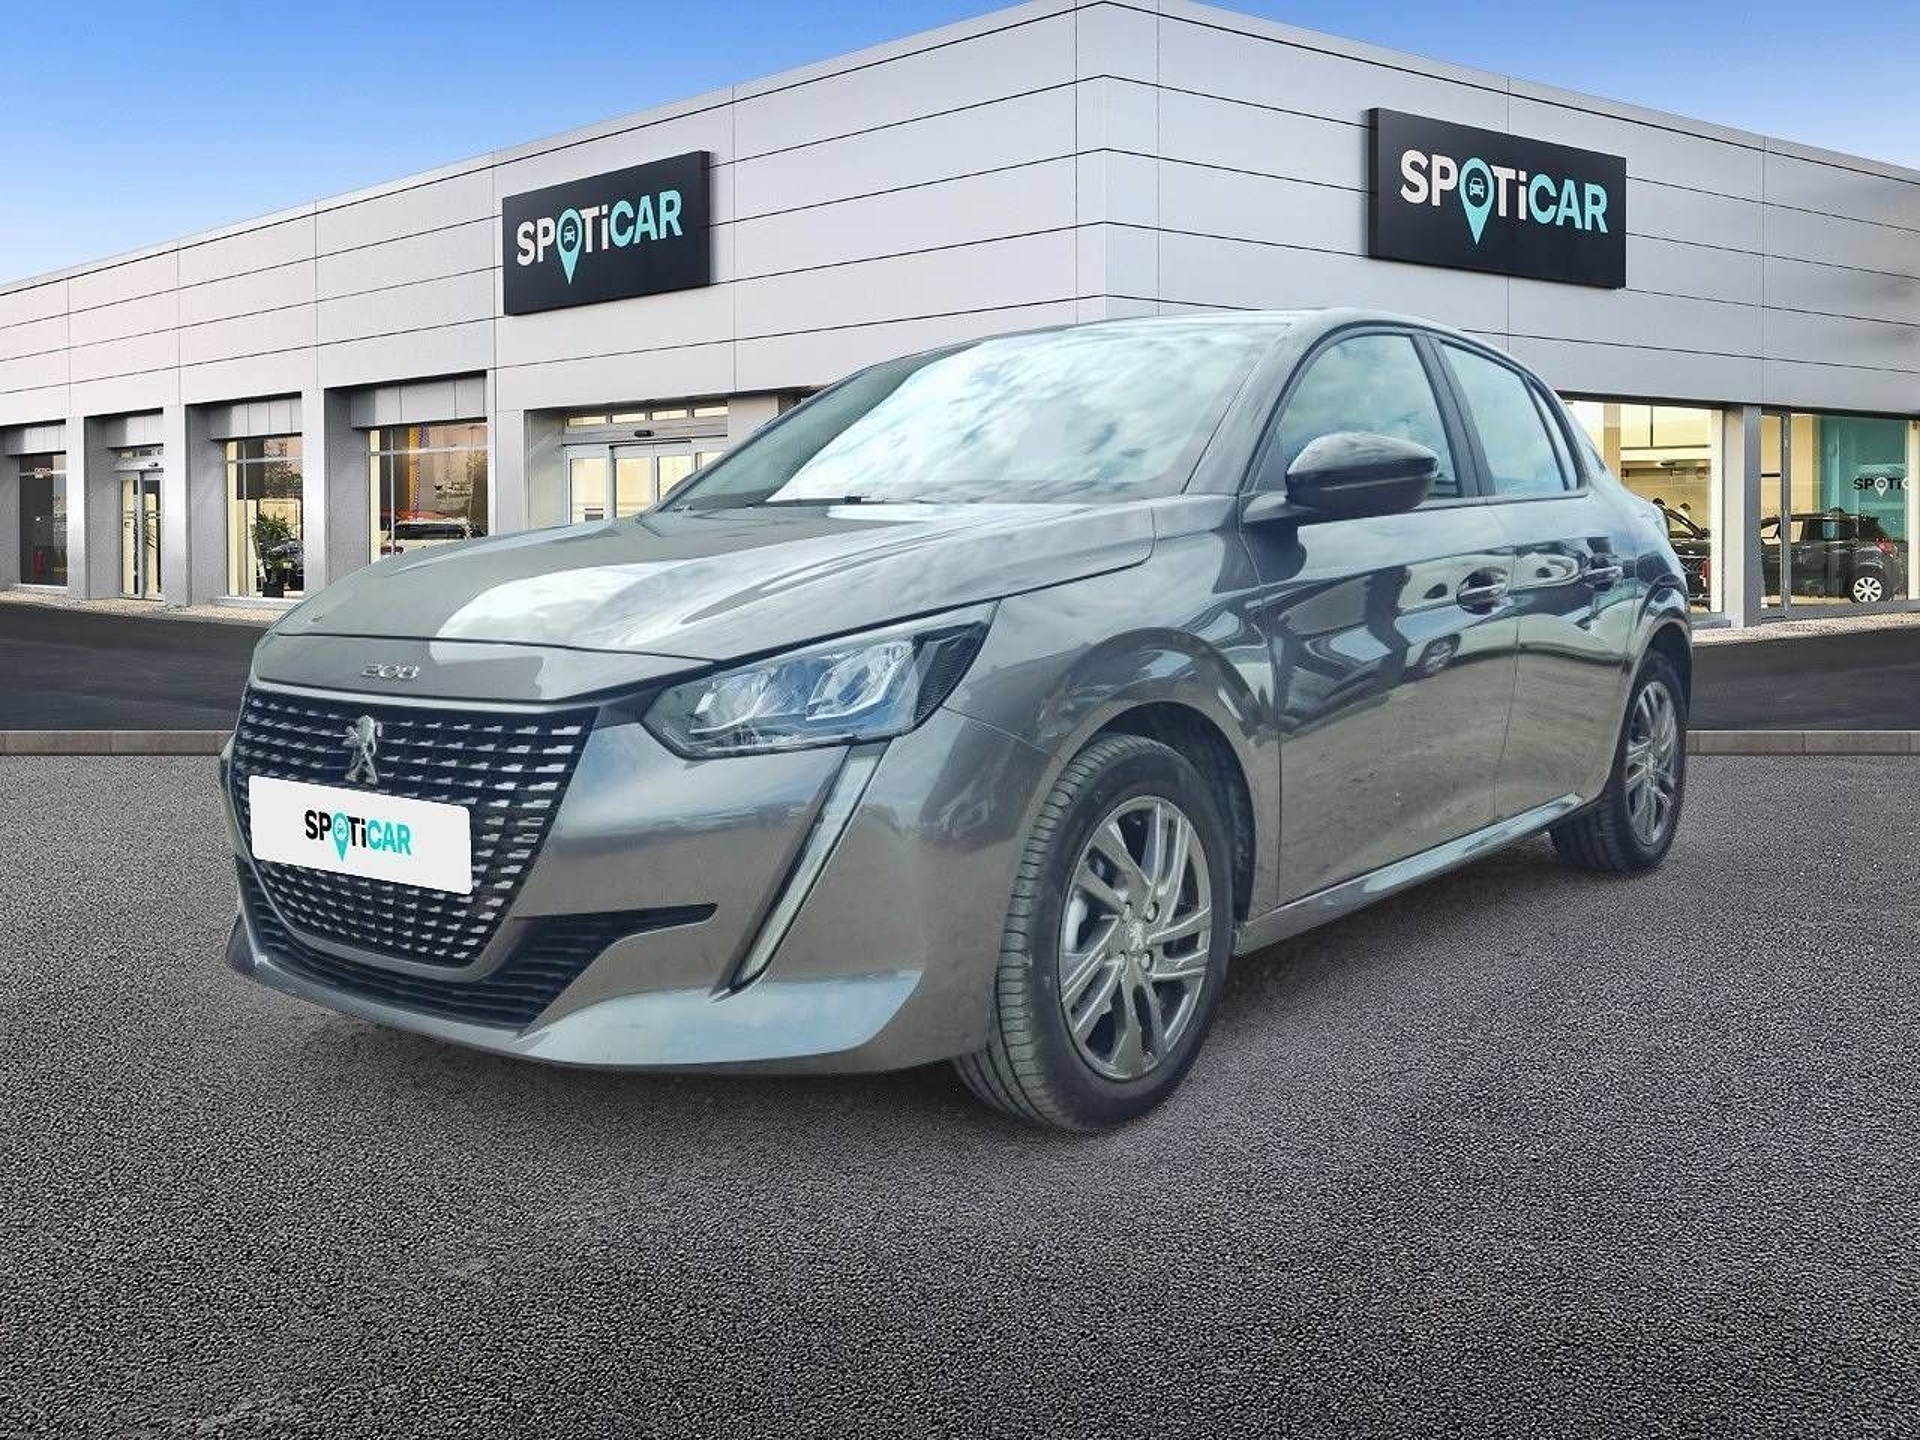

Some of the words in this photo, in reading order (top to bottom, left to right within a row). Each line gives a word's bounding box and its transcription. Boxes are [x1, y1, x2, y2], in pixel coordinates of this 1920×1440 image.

[516, 190, 683, 284] SPOTiCAR
[1400, 150, 1608, 245] SPOTiCAR
[305, 810, 411, 861] SPOTiCAR
